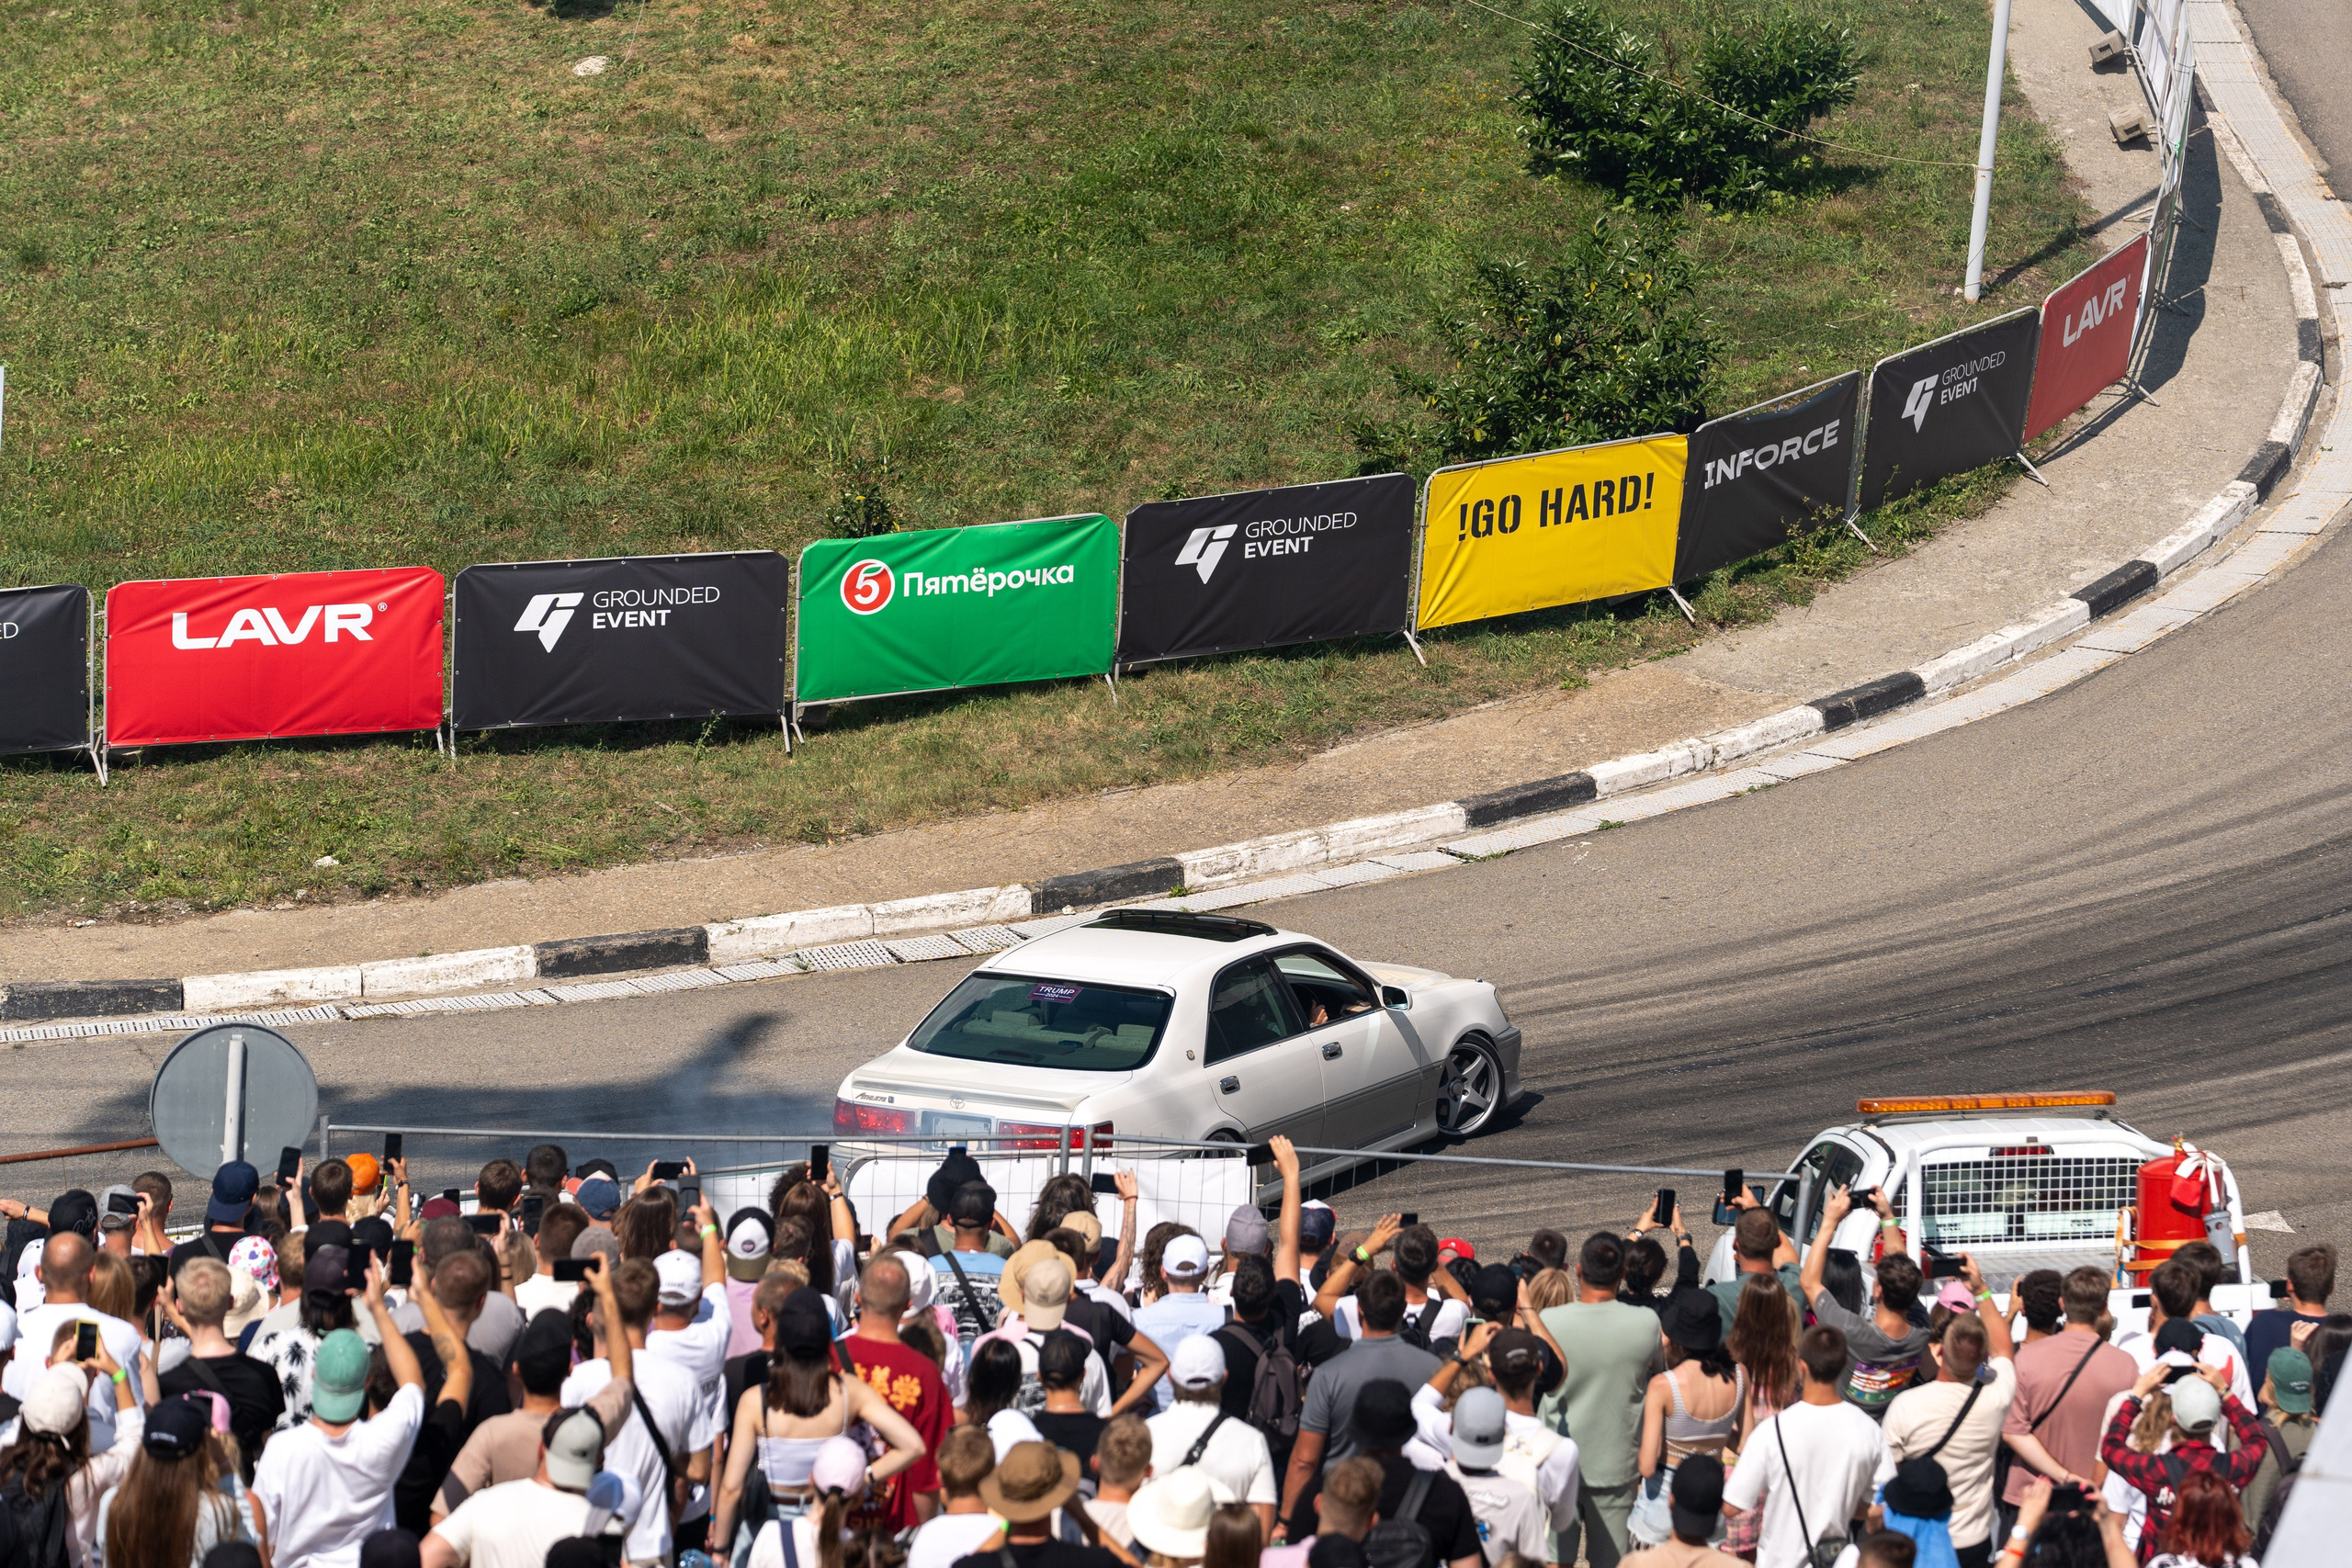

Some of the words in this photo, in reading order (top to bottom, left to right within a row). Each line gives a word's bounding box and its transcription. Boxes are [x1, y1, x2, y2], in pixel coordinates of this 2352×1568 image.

[2063, 277, 2127, 348] LAVR
[1942, 351, 2006, 386] GROUNDED
[1940, 377, 1978, 405] EVENT
[1704, 418, 1840, 490] INFORCE
[1458, 494, 1521, 542] !GO
[1539, 472, 1655, 527] HARD!
[1245, 512, 1357, 538] GROUNDED
[1244, 536, 1314, 559] EVENT
[903, 564, 1074, 598] Пятёрочка
[593, 586, 720, 608] GROUNDED
[593, 609, 672, 629] EVENT
[1039, 986, 1076, 995] TRUMP
